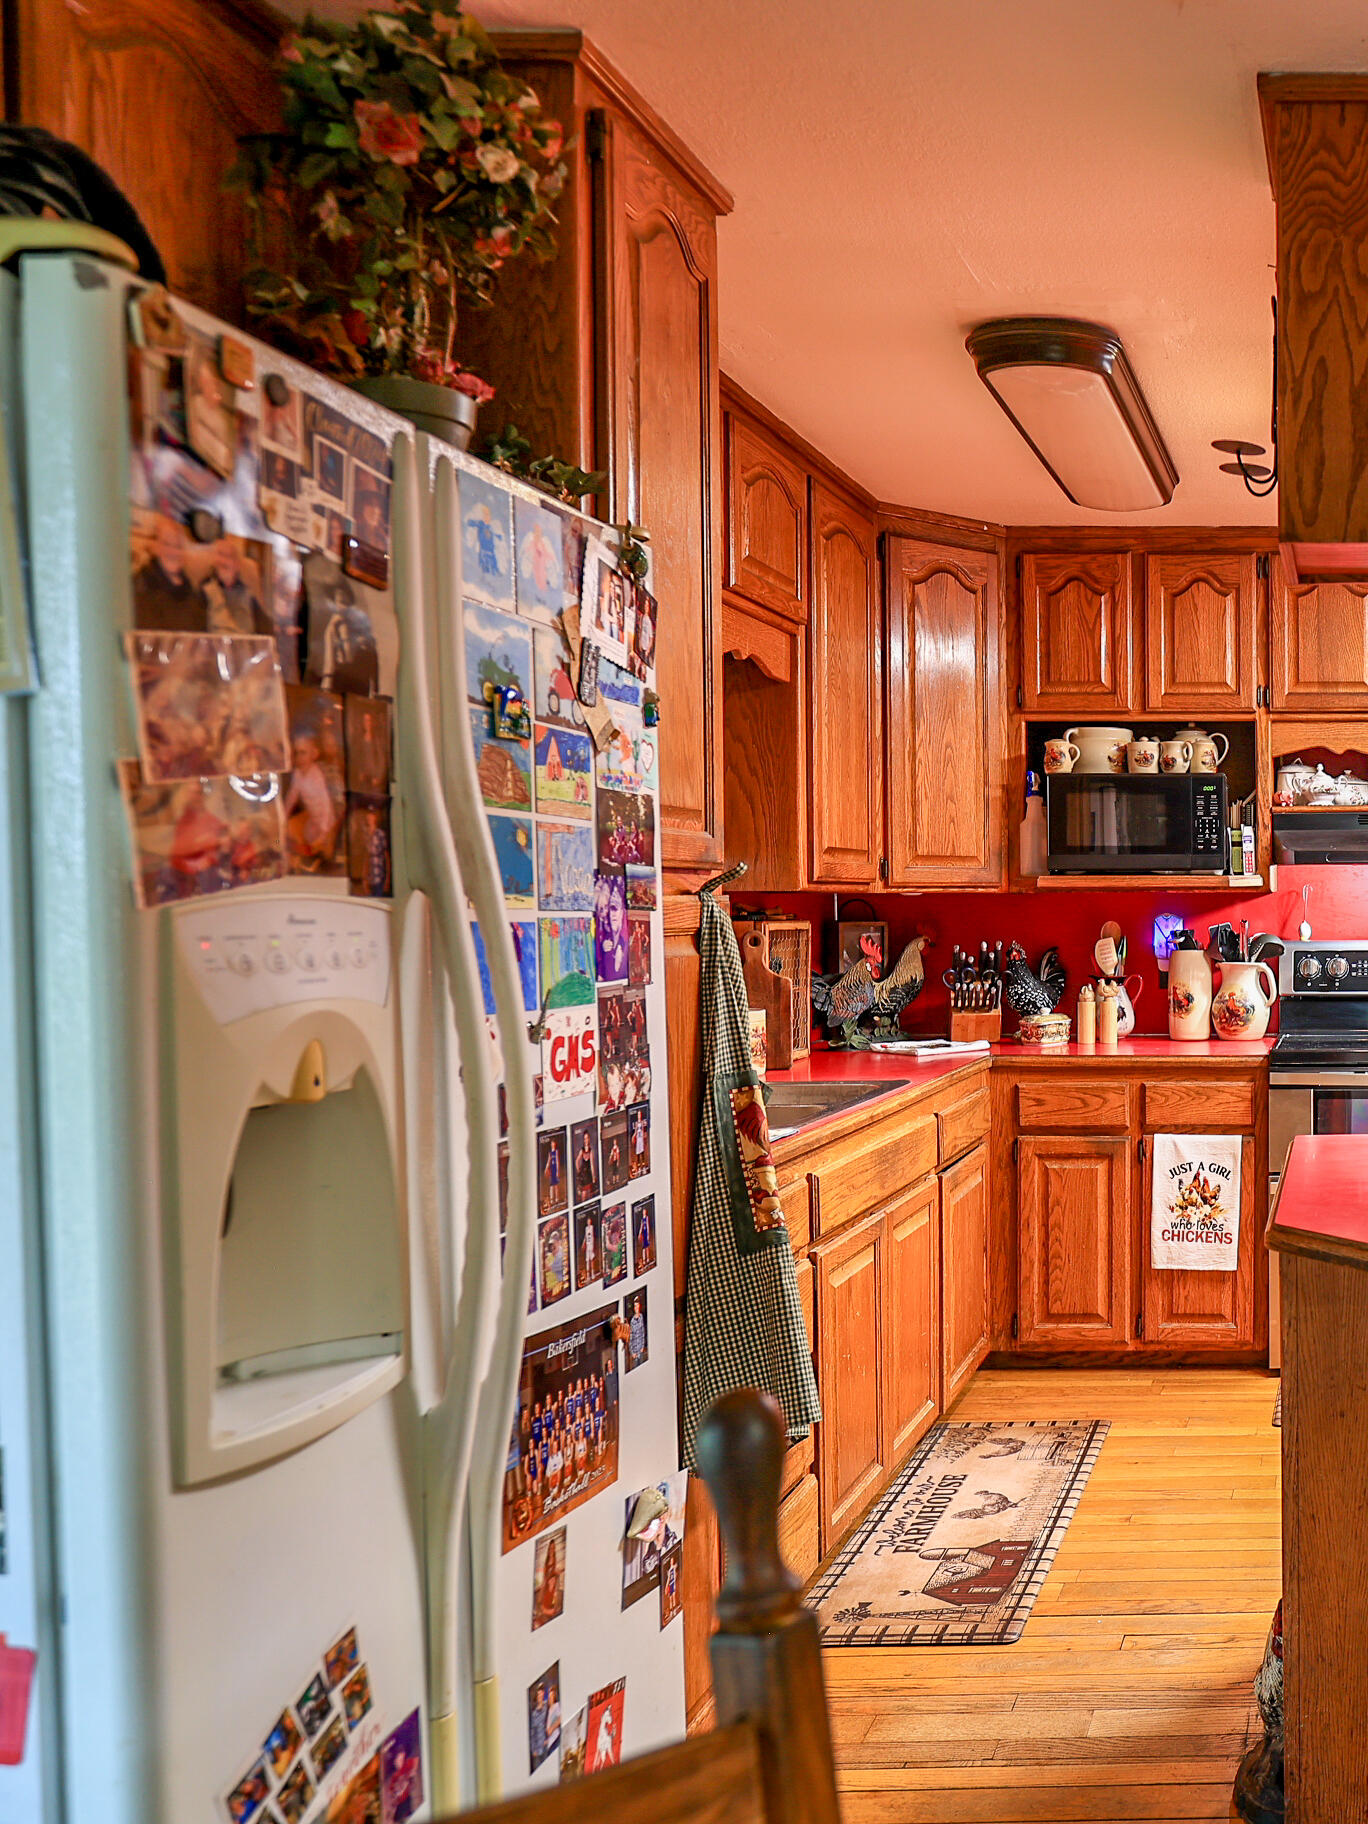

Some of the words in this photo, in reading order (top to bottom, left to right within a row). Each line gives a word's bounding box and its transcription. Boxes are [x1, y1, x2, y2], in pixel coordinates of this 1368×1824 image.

[1168, 1161, 1194, 1180] JUST
[1198, 1161, 1206, 1172] A
[1208, 1162, 1232, 1181] GIRL
[1161, 1228, 1233, 1245] CHICKENS
[1170, 1218, 1194, 1231] who
[1196, 1218, 1225, 1232] loves
[547, 1328, 587, 1360] Bakersfield
[893, 1474, 967, 1553] FARMHOUSE
[874, 1509, 915, 1556] Welcome
